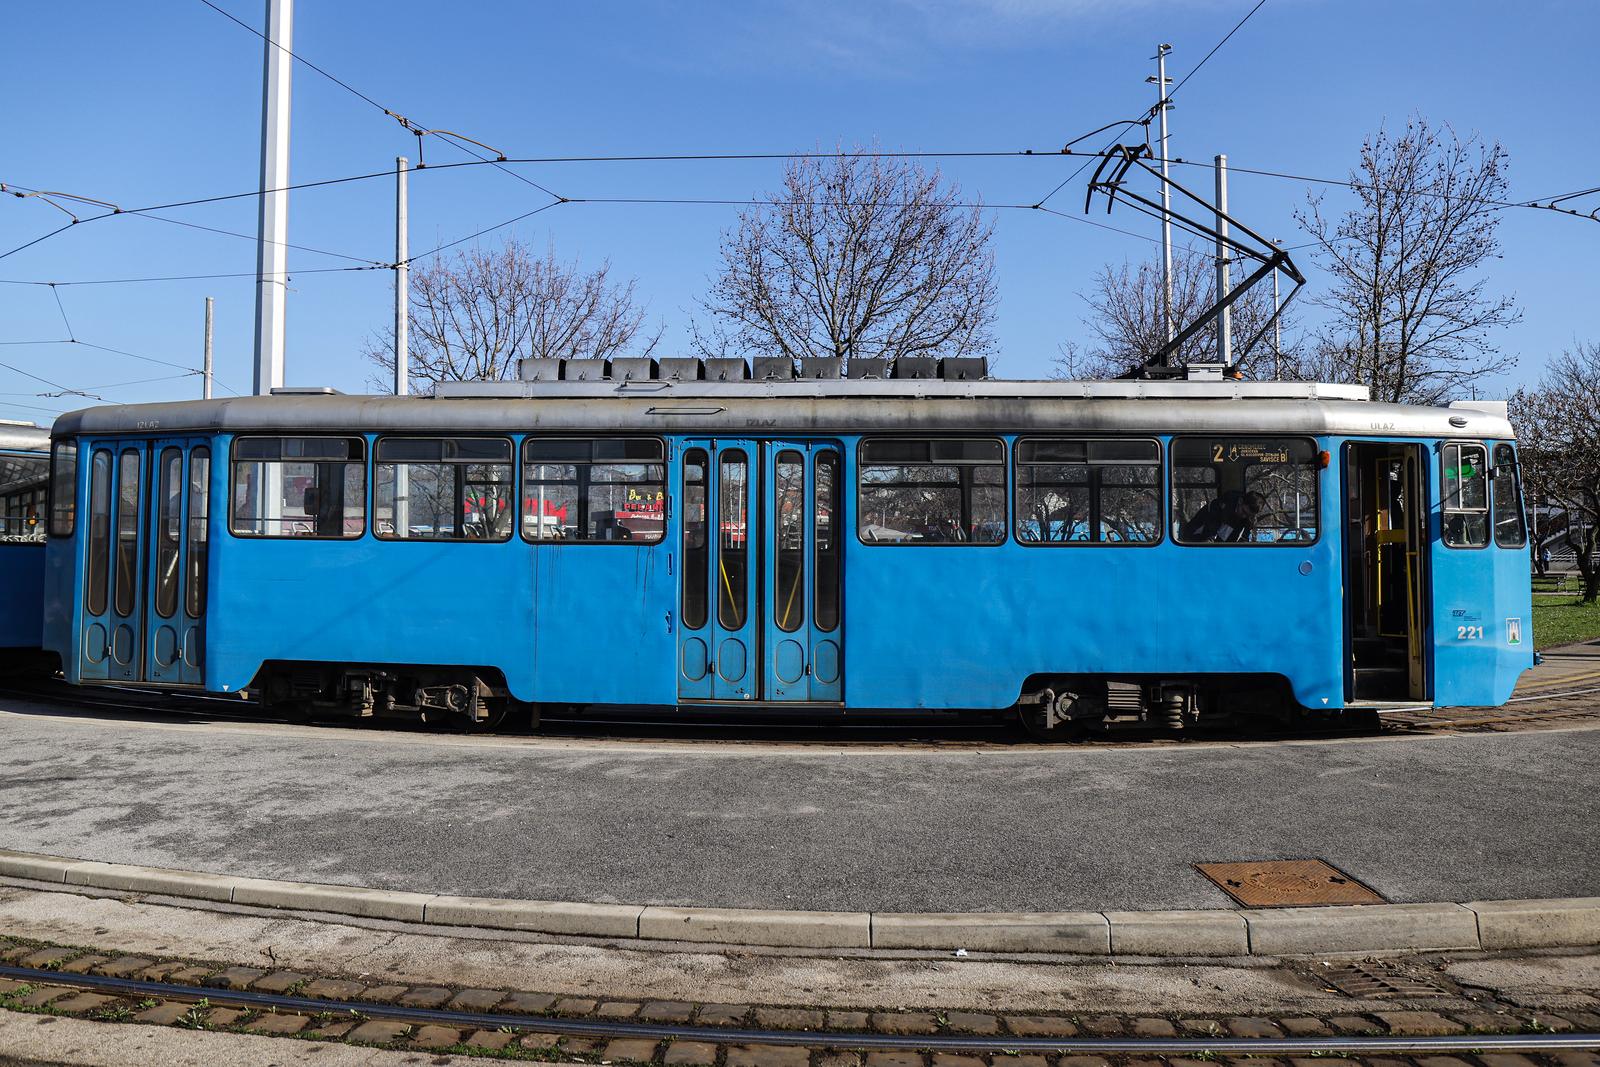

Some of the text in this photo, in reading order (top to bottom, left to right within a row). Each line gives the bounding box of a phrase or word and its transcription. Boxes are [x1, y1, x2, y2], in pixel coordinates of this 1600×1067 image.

[136, 420, 160, 429] IZLAZ
[746, 418, 777, 427] IZLAZ
[1370, 422, 1395, 430] ULAZ
[1213, 444, 1224, 462] 2
[1280, 453, 1286, 462] B
[1457, 625, 1484, 640] 221
